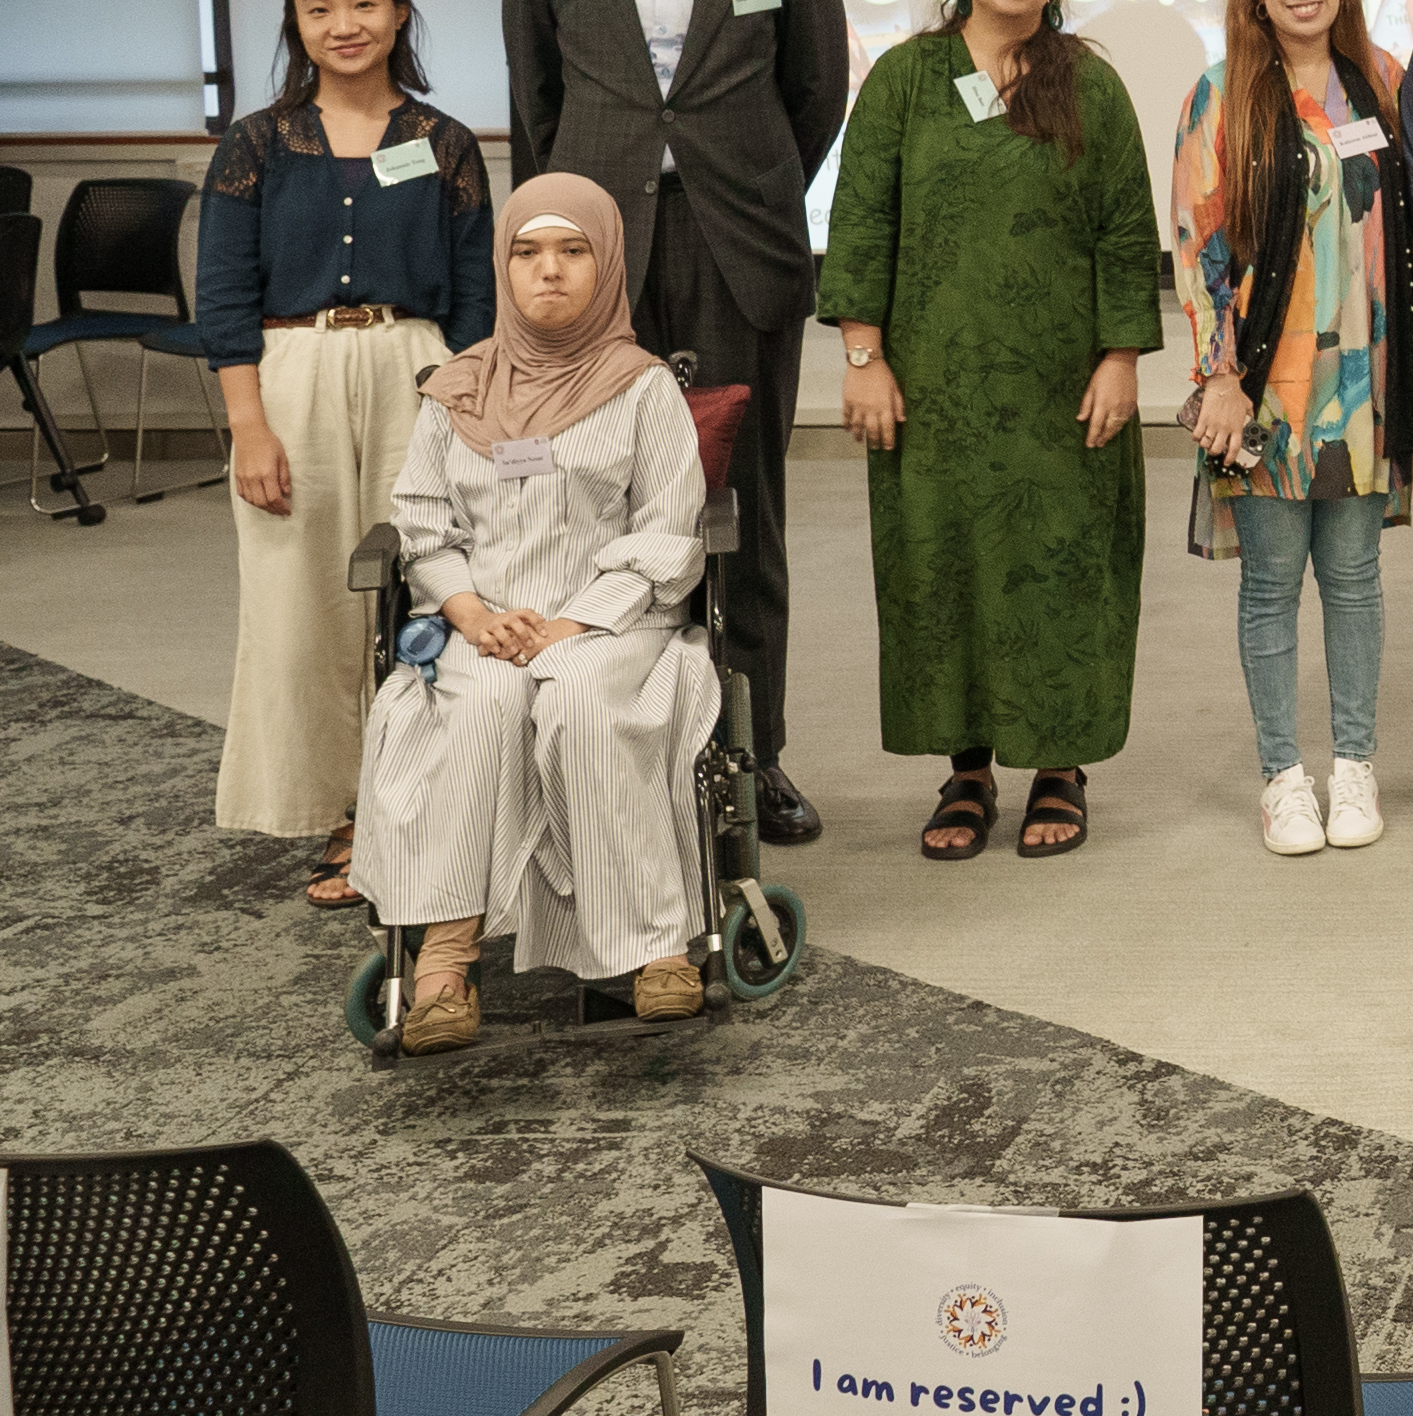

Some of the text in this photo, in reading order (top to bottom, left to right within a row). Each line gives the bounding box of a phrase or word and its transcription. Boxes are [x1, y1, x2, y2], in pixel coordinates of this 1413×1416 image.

[955, 1282, 981, 1292] equity
[813, 1358, 822, 1392] I
[836, 1374, 895, 1402] am
[911, 1381, 1104, 1416] reserved
